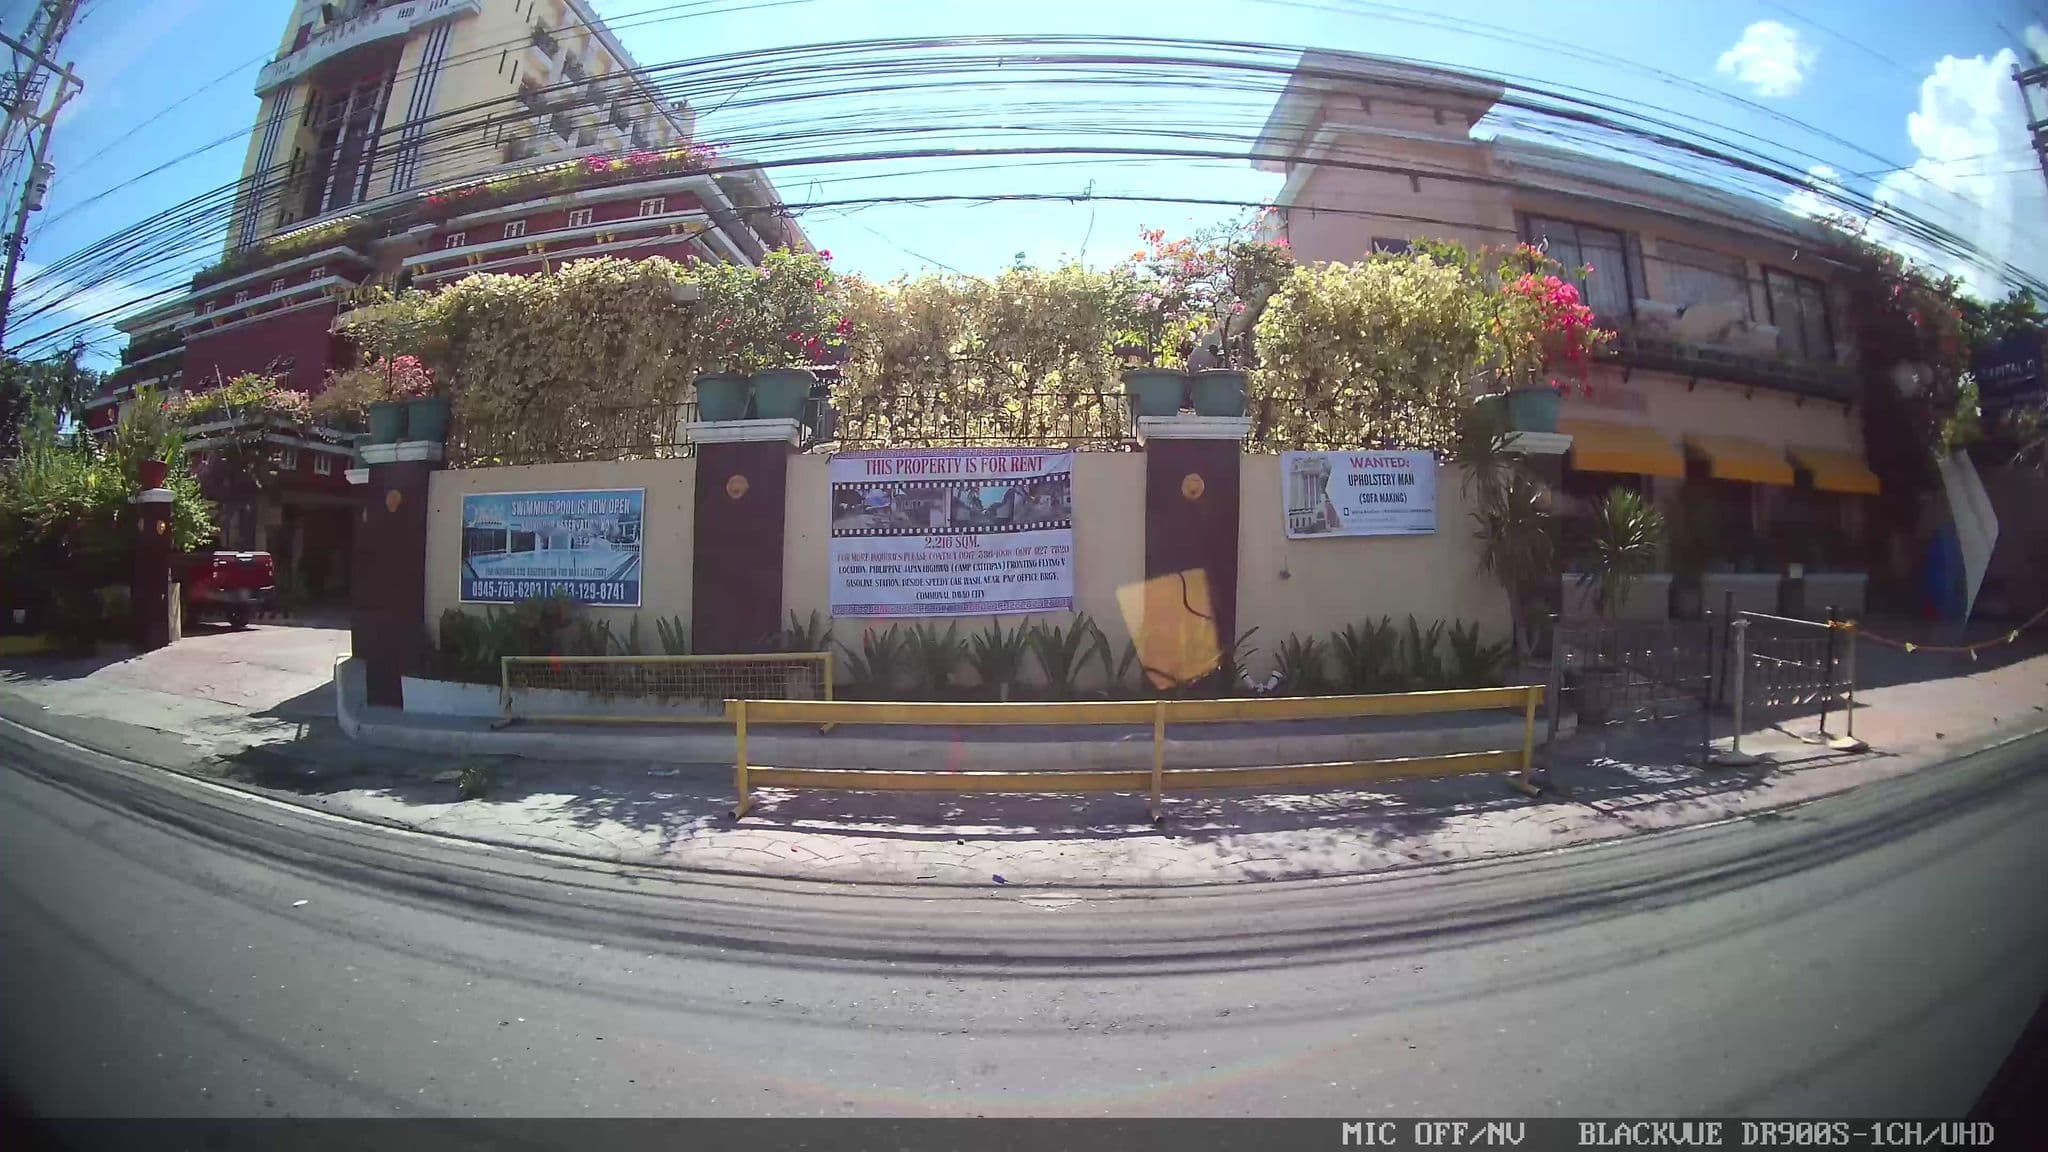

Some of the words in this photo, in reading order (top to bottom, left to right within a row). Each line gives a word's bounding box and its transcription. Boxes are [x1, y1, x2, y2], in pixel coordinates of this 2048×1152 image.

[865, 458, 892, 475] THIS
[896, 457, 961, 475] PROPERTY
[966, 457, 977, 473] IS
[981, 456, 1006, 473] FOR
[1011, 455, 1044, 472] RENT
[1350, 457, 1410, 468] WANTED:
[1348, 474, 1395, 487] UPHOLSTERY
[1397, 473, 1415, 486] MAN
[1359, 493, 1378, 505] (SOFA
[1379, 492, 1407, 504] MAKING)
[512, 500, 552, 516] SWIMMING
[554, 500, 575, 515] POOL
[577, 500, 585, 514] IS
[586, 499, 608, 514] NOW
[609, 498, 630, 514] OPEN
[956, 535, 980, 548] SQM.
[846, 579, 873, 588] GASOLINE
[1017, 573, 1038, 582] OFFICE
